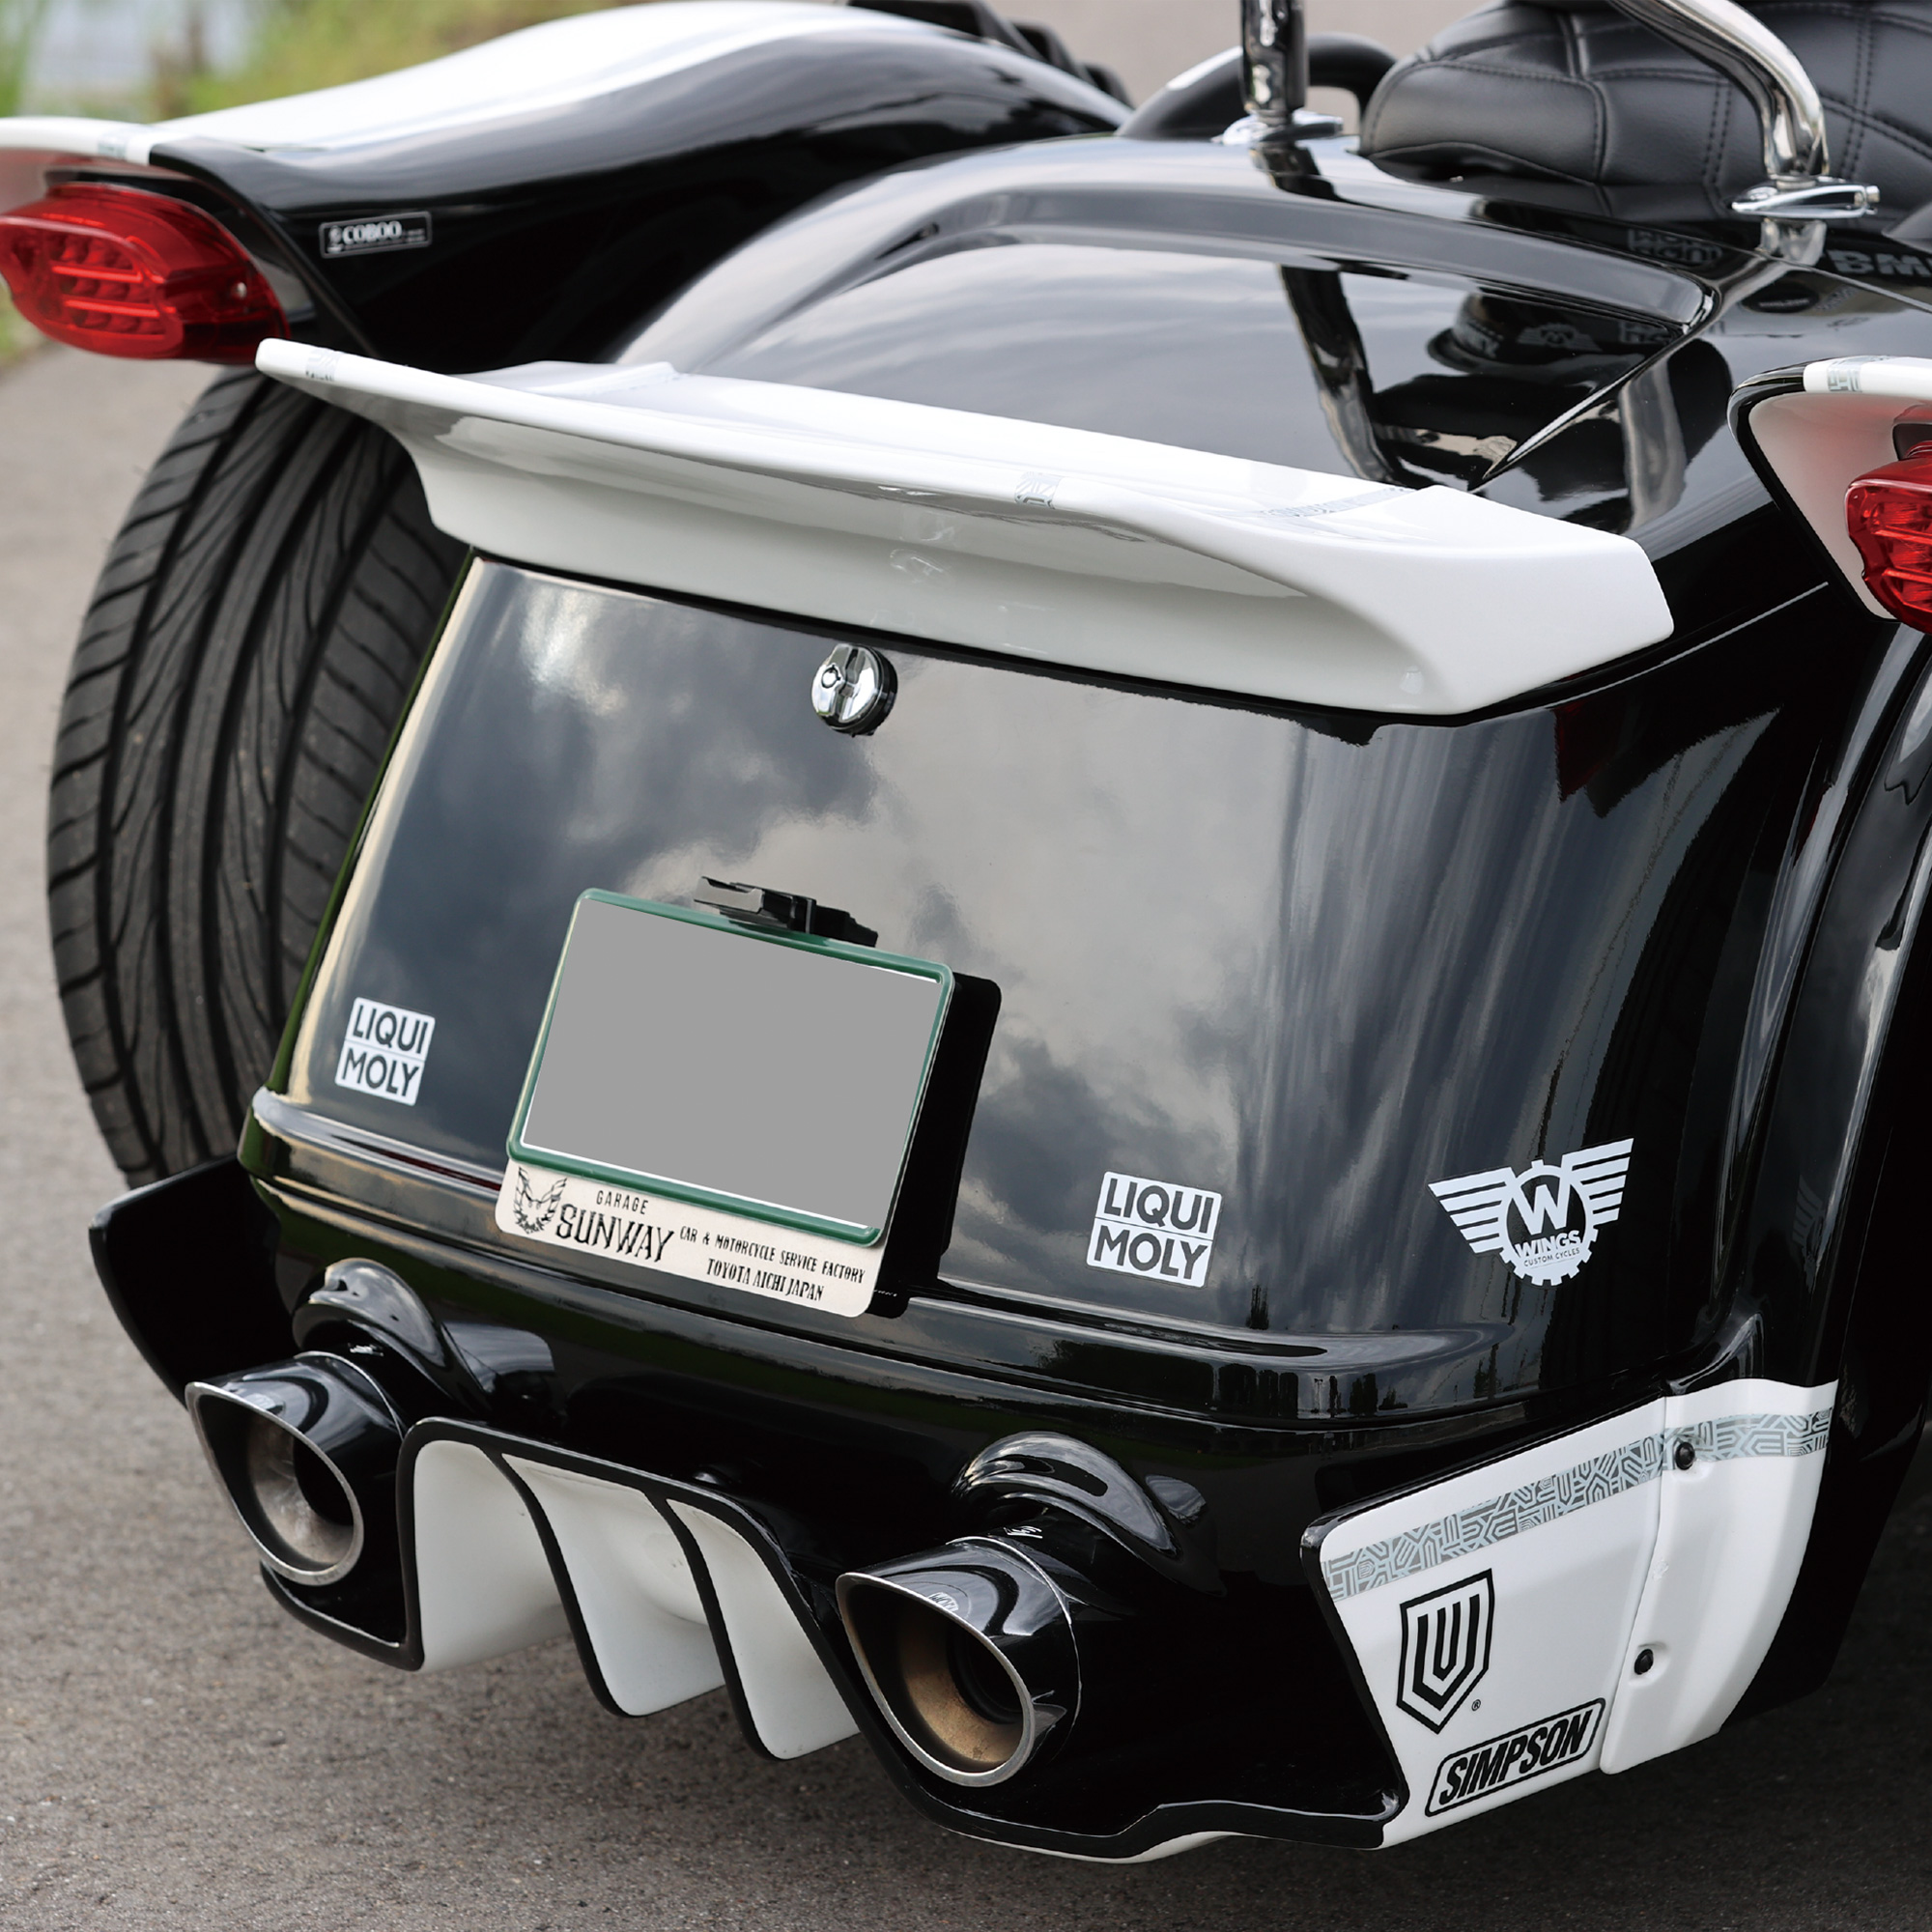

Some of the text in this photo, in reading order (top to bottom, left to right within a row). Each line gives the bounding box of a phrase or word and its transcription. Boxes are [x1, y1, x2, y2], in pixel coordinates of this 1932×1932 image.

[1826, 248, 1932, 278] BM
[353, 1005, 428, 1054] LIQUI
[342, 1047, 419, 1096] MOLY
[596, 1190, 648, 1214] GARAGE
[1103, 1178, 1214, 1234] LIQUI
[555, 1204, 675, 1263] SUNWAY
[679, 1226, 866, 1284] CAR & MOTORCYCLE SERVICE FACTORY
[1094, 1225, 1208, 1280] MOLY
[1514, 1230, 1581, 1258] WINGS
[1523, 1247, 1580, 1267] CUSTOM CYCLES
[706, 1258, 825, 1302] TOYOTA AICHI JAPAN
[1438, 1708, 1593, 1805] SIMPSON
